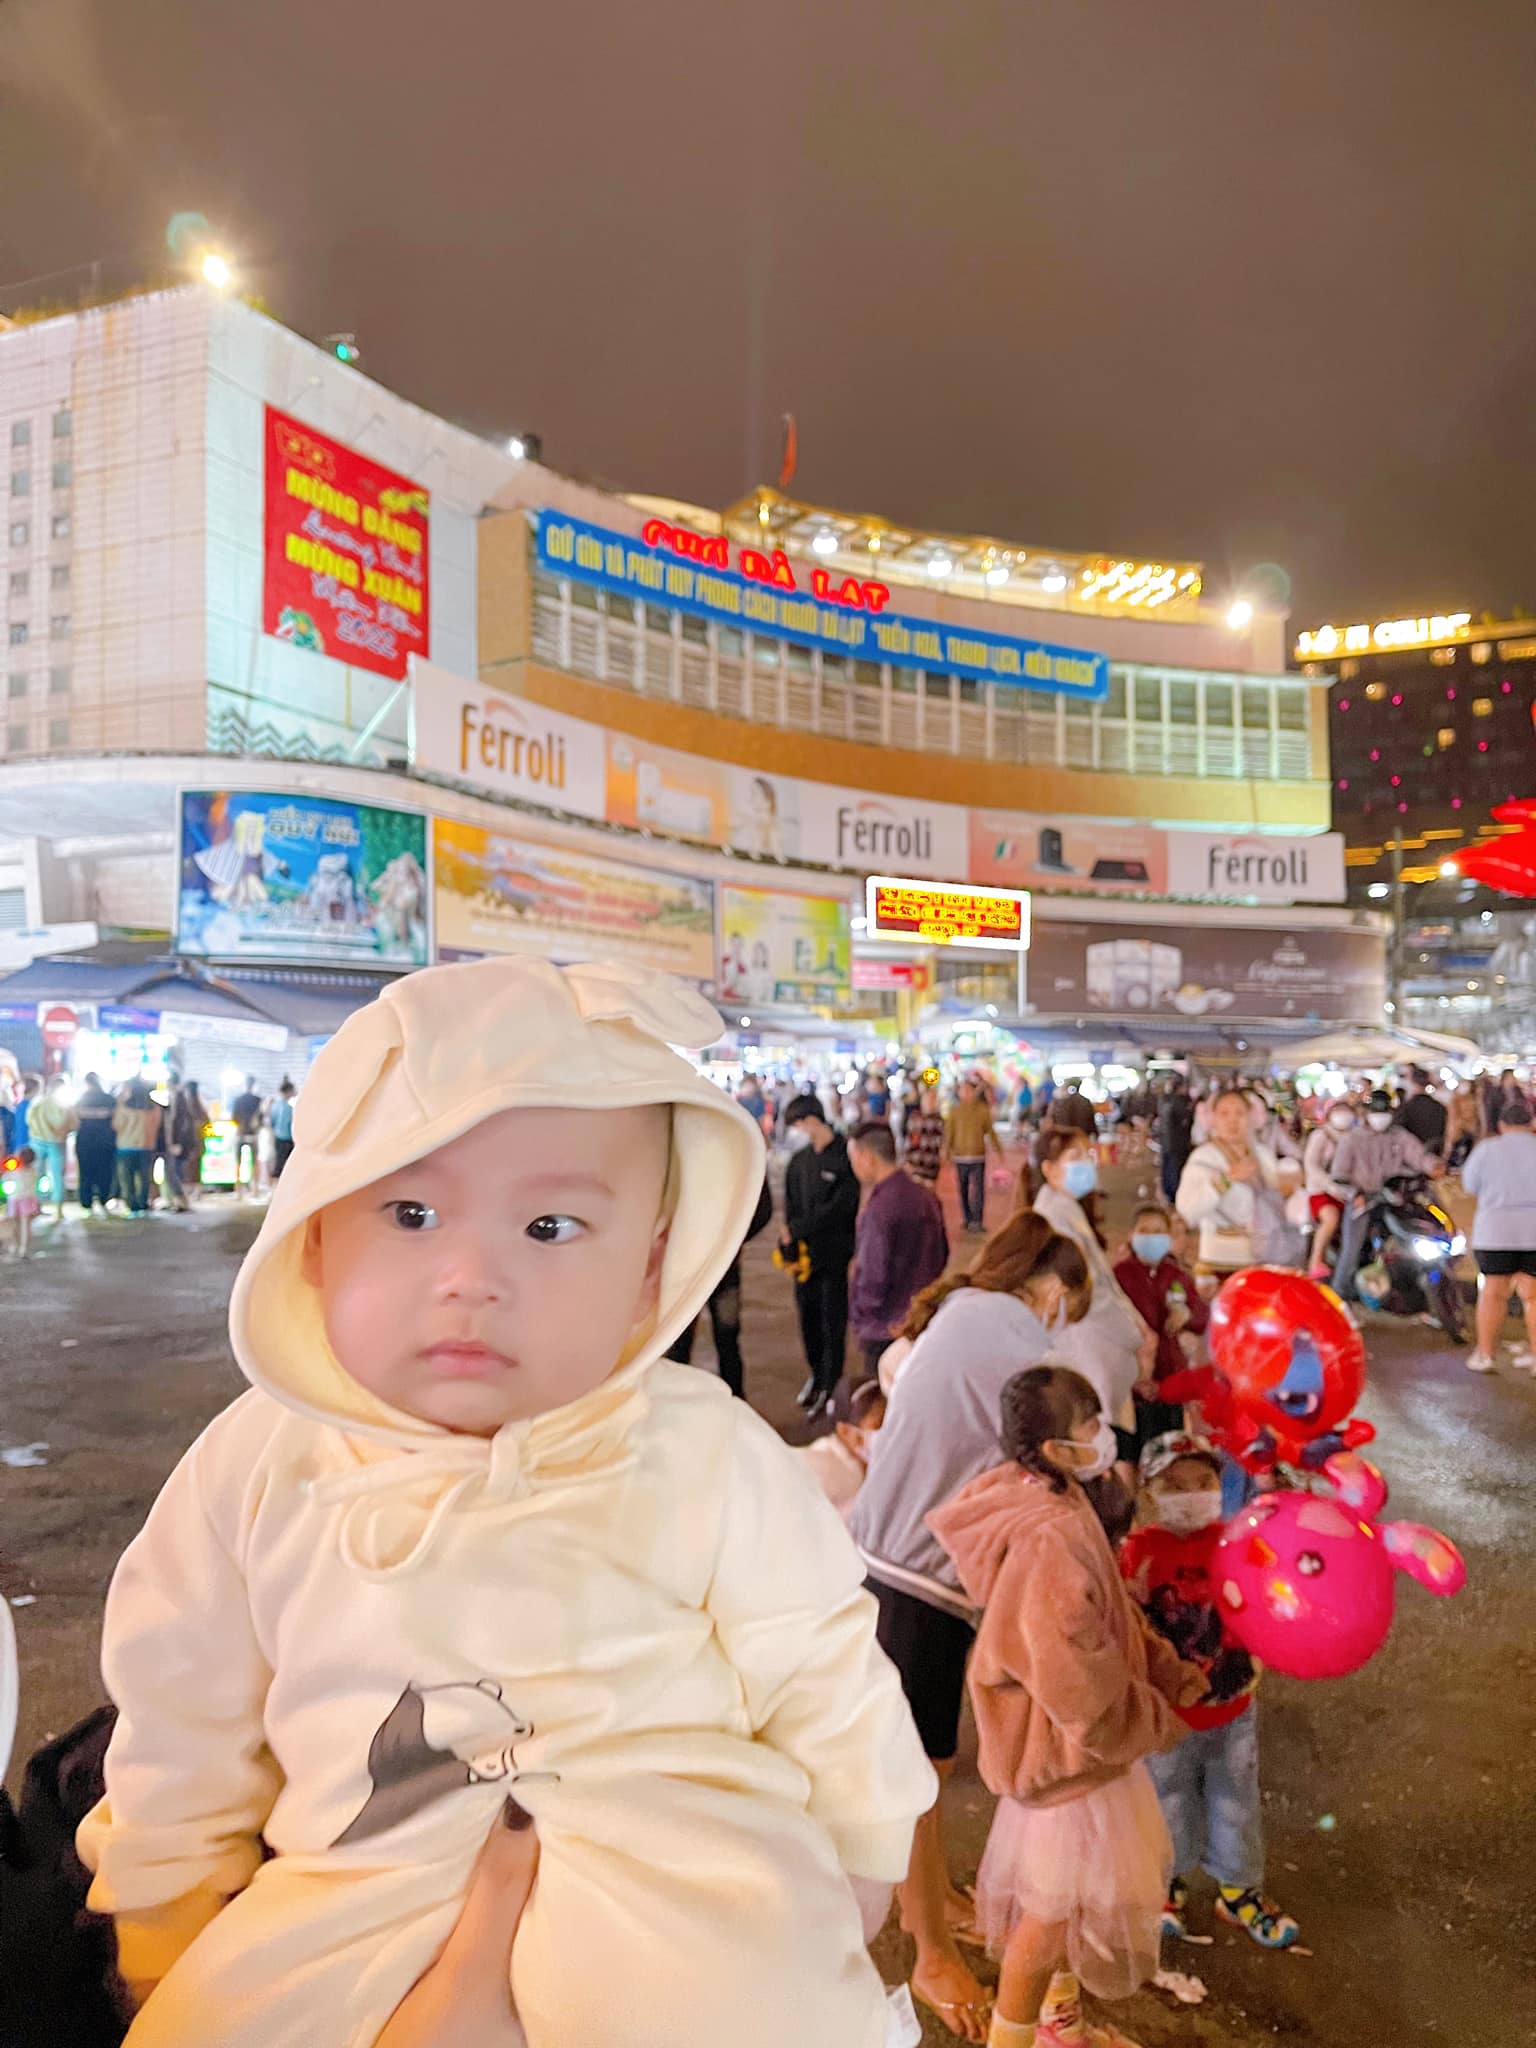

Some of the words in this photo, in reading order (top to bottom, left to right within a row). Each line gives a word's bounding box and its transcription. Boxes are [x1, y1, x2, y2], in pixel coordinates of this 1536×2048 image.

[336, 611, 397, 659] 2022
[460, 702, 566, 789] Ferroli
[837, 806, 931, 859] Ferroli
[1208, 844, 1308, 889] Ferroli
